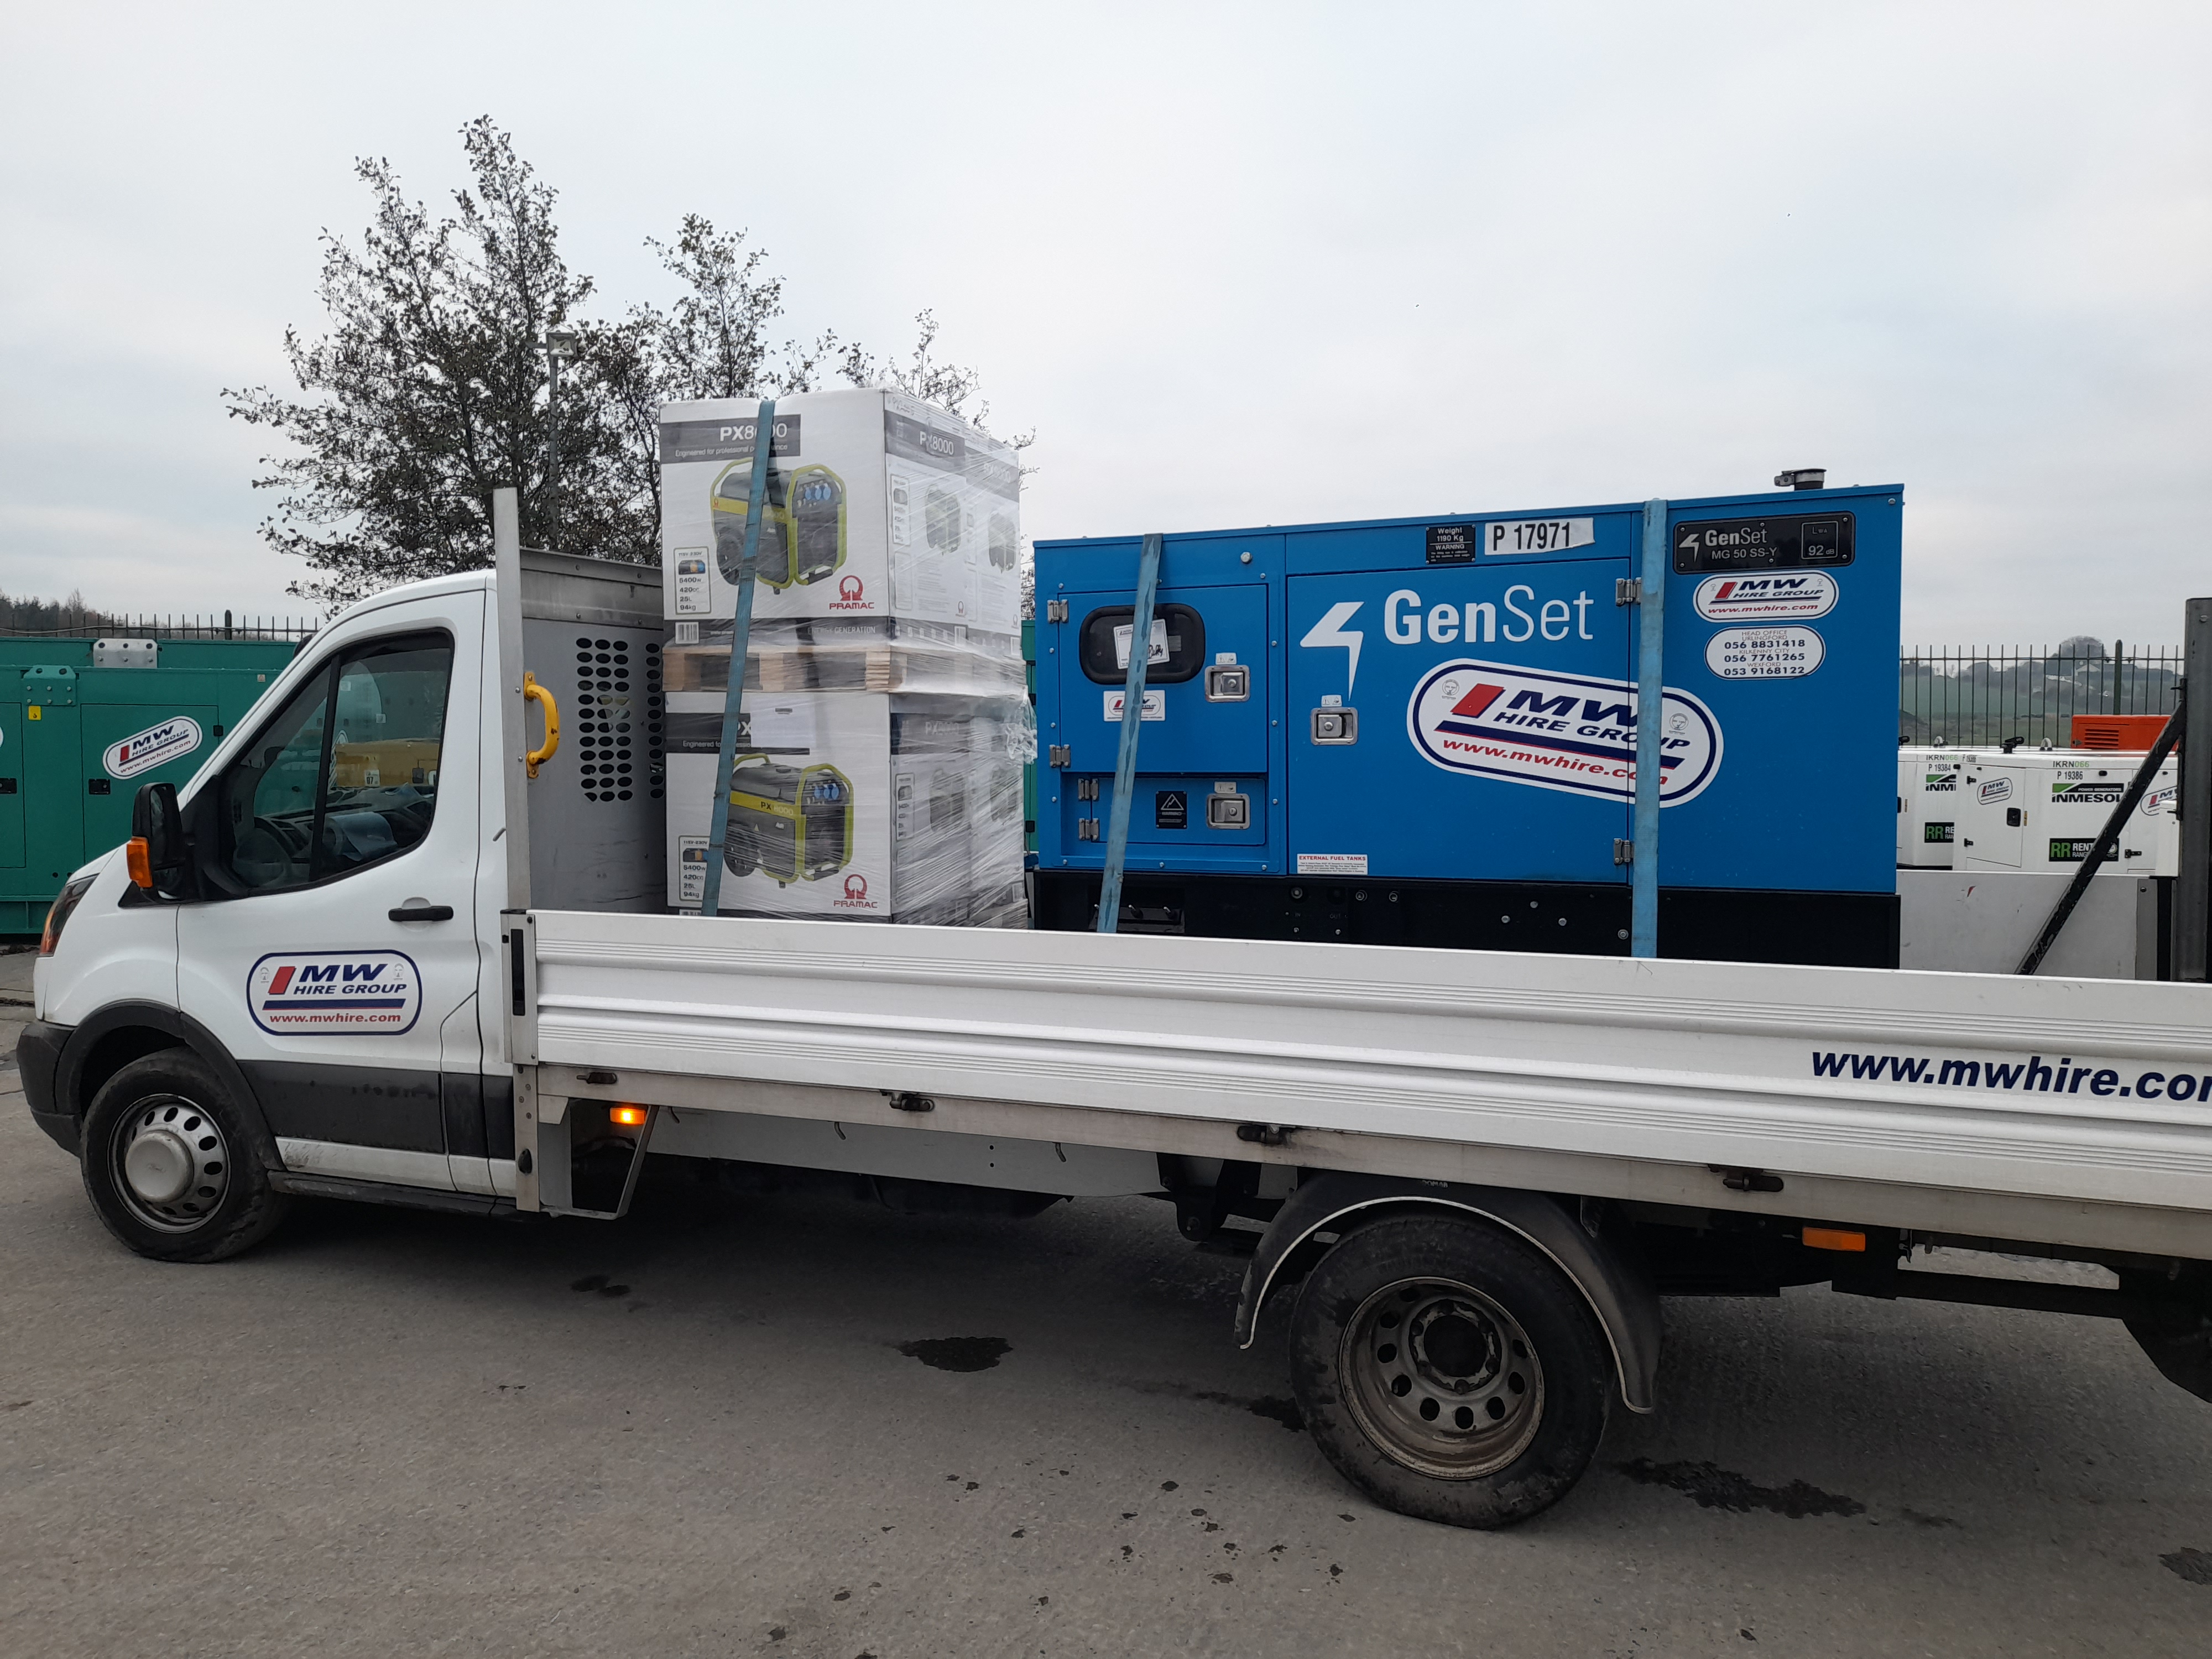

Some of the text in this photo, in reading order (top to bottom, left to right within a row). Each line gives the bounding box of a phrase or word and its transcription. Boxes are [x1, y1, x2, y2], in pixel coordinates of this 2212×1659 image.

[720, 423, 787, 441] PX80
[1437, 526, 1463, 535] Weight
[1494, 521, 1571, 551] P 17971
[1453, 534, 1464, 542] Kg
[1705, 527, 1767, 546] GenSet
[1712, 547, 1777, 560] MG 50 SS-Y
[1808, 545, 1824, 556] 92
[1739, 578, 1808, 591] MW
[830, 602, 875, 610] PRAMAC
[1708, 605, 1818, 614] www.mwhire.com
[1384, 584, 1594, 645] GenSet
[834, 626, 876, 634] GENERATION
[1724, 639, 1806, 649] 056 8831418
[1751, 653, 1805, 662] 7761265
[1724, 666, 1804, 676] 053 9168122
[1493, 711, 1571, 733] HIRE
[132, 724, 174, 750] MW
[132, 728, 189, 757] HIRE GROUP
[121, 740, 191, 773] www.mwhire.com
[1934, 764, 1951, 772] 19384
[2057, 771, 2083, 780] P 19386
[1987, 780, 2005, 790] MW
[1926, 826, 1944, 839] RR
[2051, 842, 2071, 858] RR
[299, 963, 388, 982] MW
[293, 984, 407, 995] HIRE GROUP
[270, 1013, 401, 1022] www.mwhire.com
